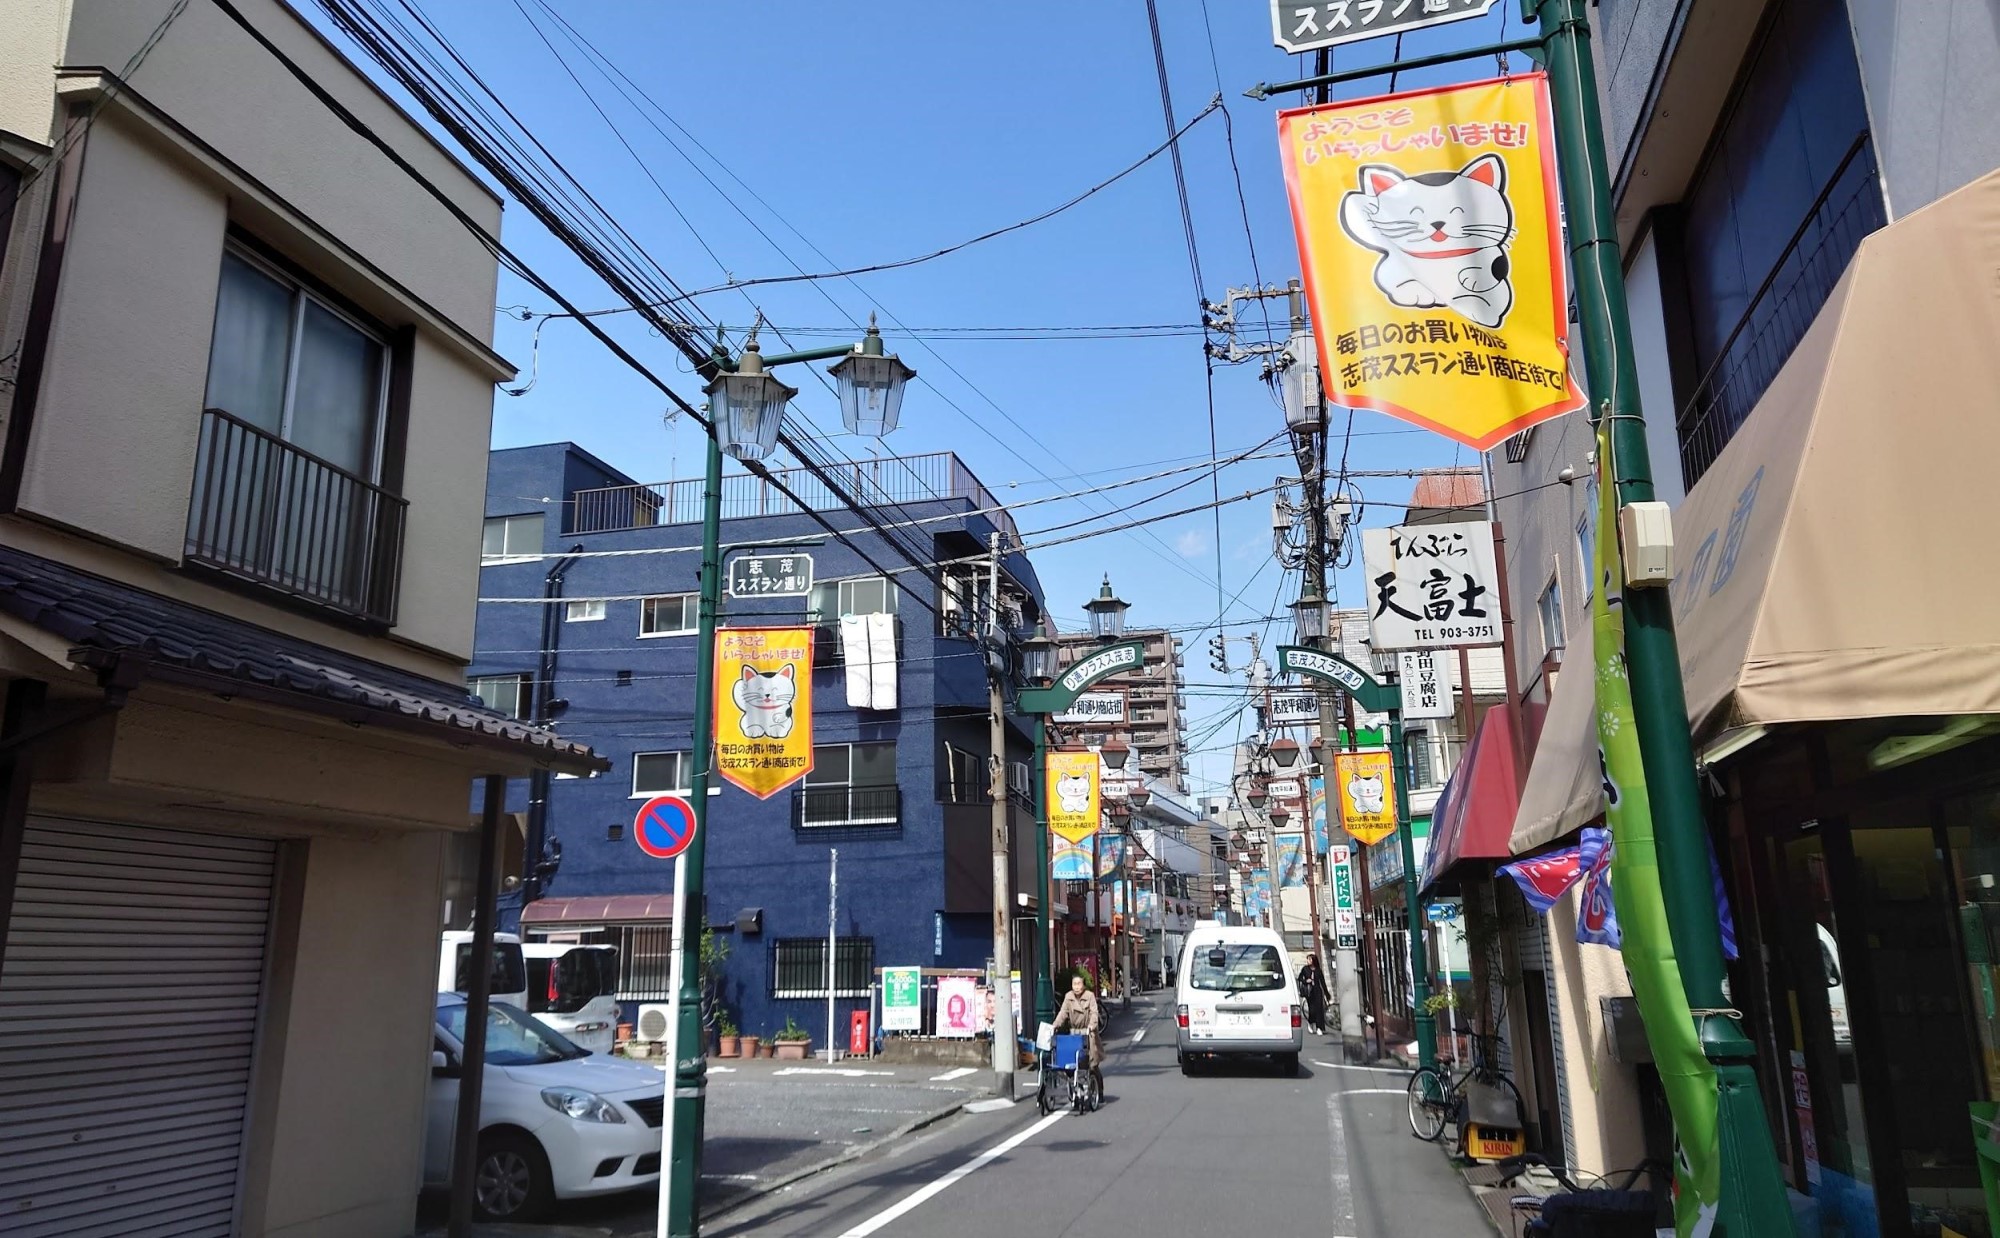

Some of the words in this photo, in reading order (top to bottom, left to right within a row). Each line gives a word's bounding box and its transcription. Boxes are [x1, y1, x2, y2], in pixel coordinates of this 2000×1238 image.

[1292, 0, 1472, 38] スズラン
[1303, 107, 1413, 142] ようこそ
[1336, 319, 1508, 356] 毎日のお買い物は
[736, 575, 806, 592] スズラン通り
[1373, 568, 1487, 622] 天富士
[724, 635, 765, 646] ようこそ
[1415, 628, 1435, 640] TEL
[1440, 625, 1494, 639] 903-3751
[1288, 653, 1362, 687] 志茂スズラン通り
[1484, 1141, 1512, 1155] KIRIN
